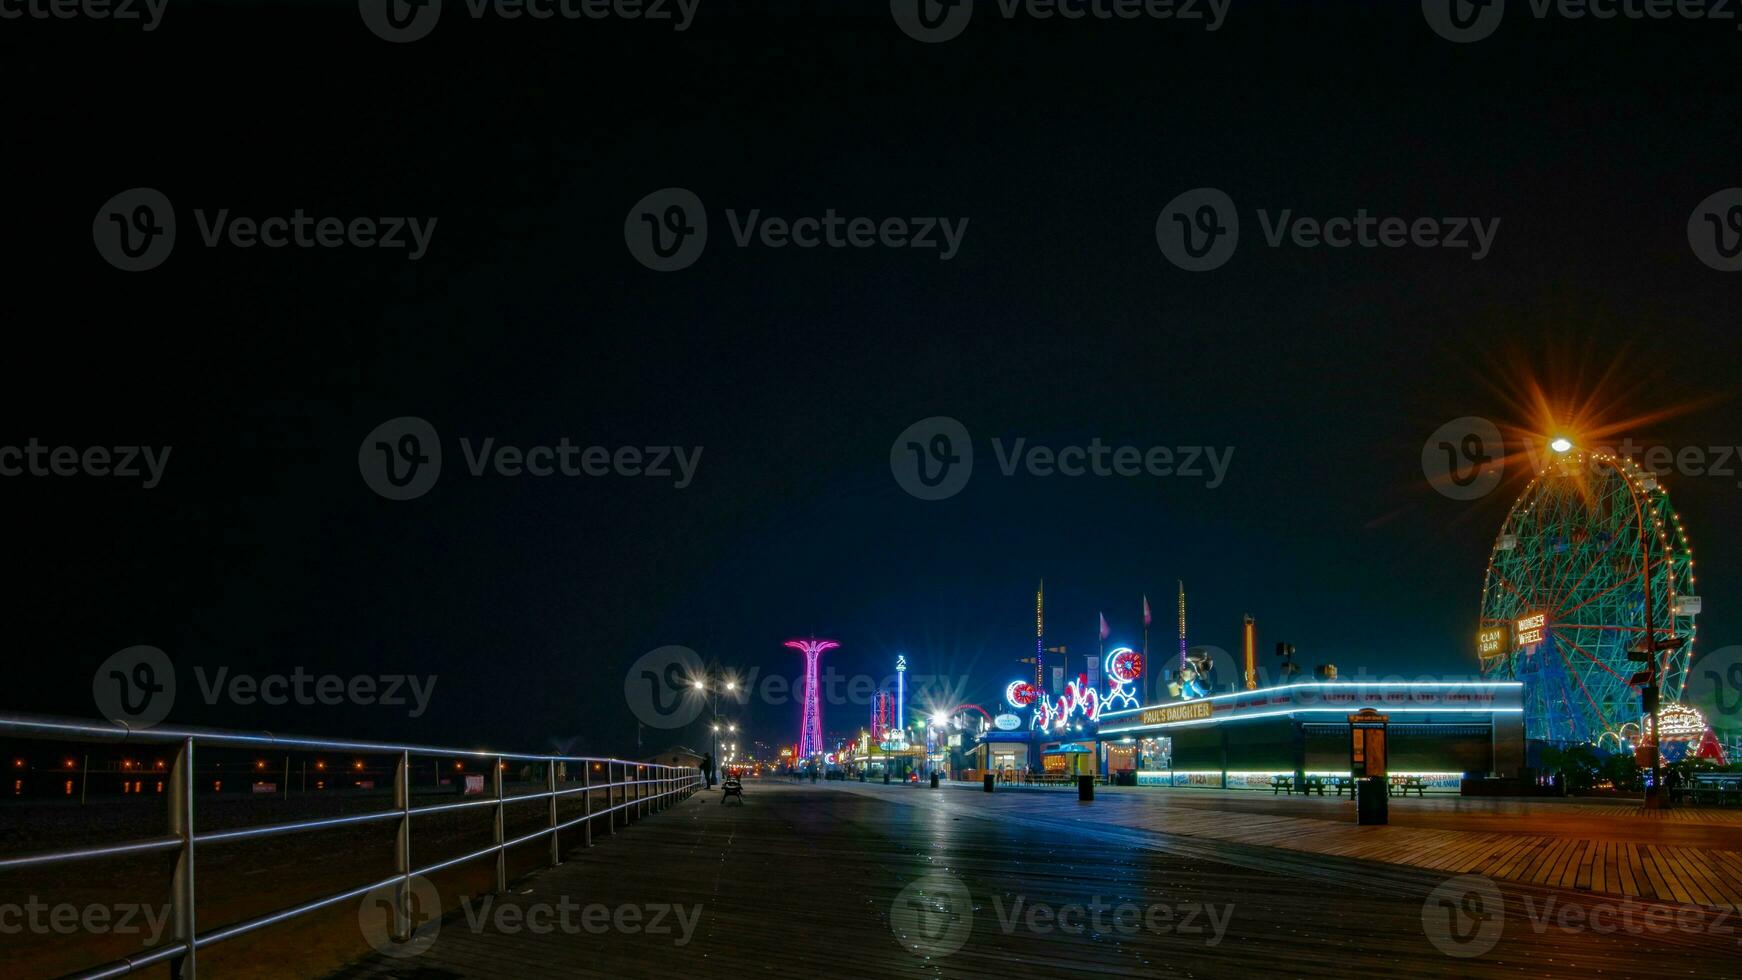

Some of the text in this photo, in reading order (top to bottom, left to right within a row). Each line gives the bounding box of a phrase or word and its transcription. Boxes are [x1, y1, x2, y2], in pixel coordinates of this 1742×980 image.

[1518, 614, 1544, 631] WONDER
[1481, 631, 1501, 643] CLAM
[1518, 629, 1542, 645] WHEEL
[1483, 641, 1498, 652] BAR
[1144, 709, 1166, 724] PAUL'S
[1166, 703, 1209, 721] DAUGHTER
[1138, 776, 1147, 784] ICE
[1148, 776, 1171, 784] CREAM
[1189, 774, 1207, 784] PIZZA
